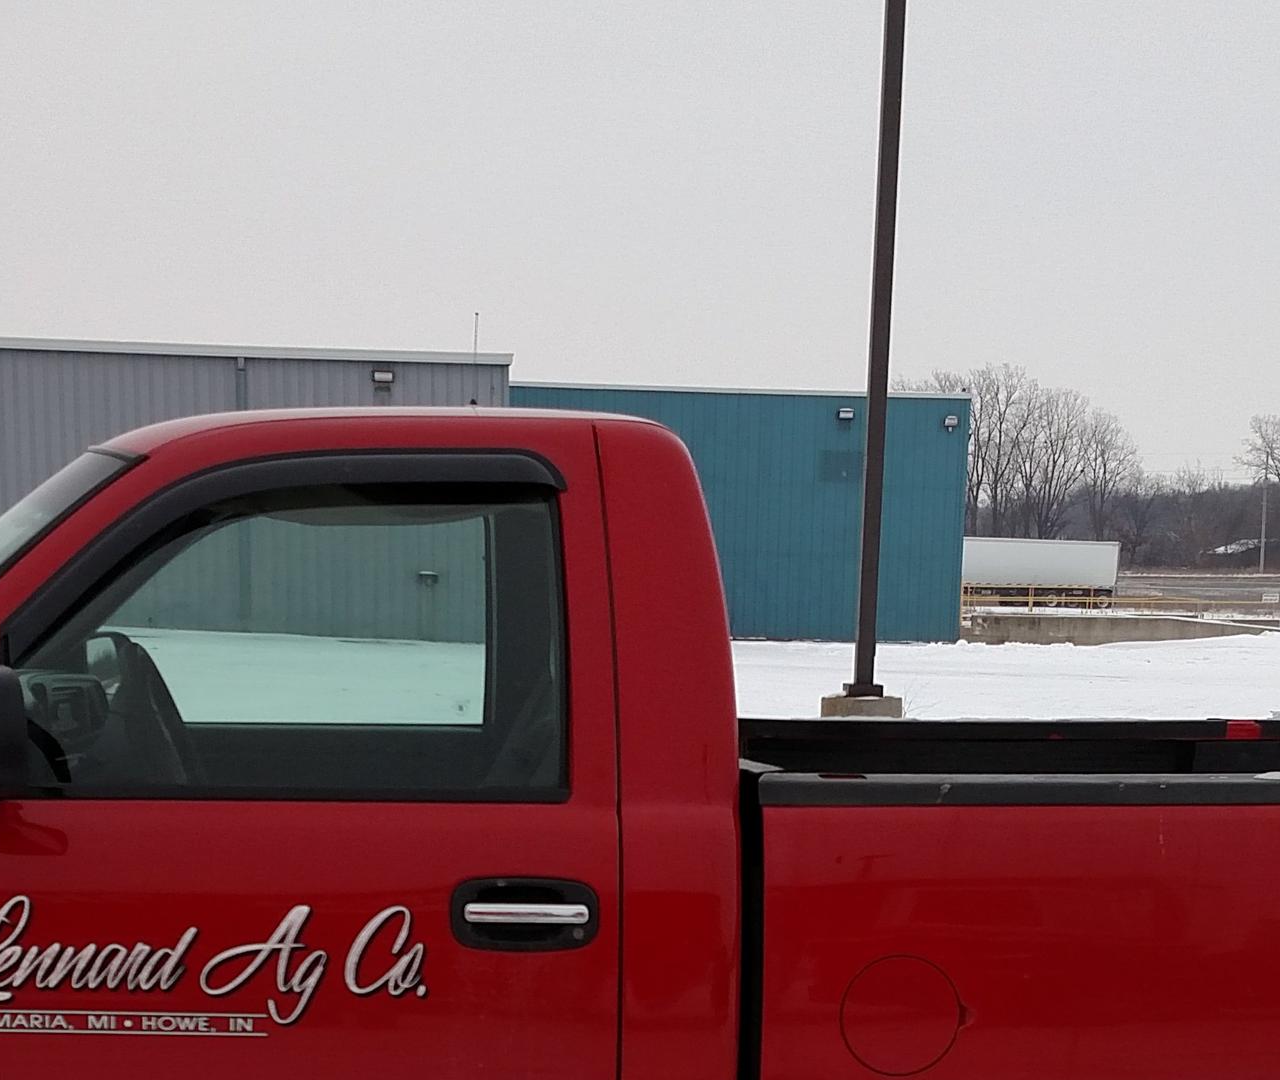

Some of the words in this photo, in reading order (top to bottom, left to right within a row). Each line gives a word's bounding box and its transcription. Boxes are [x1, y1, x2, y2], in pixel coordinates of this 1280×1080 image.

[199, 904, 327, 1024] Ag
[344, 905, 427, 996] Co.
[87, 1014, 116, 1030] MI
[229, 1017, 253, 1032] IN
